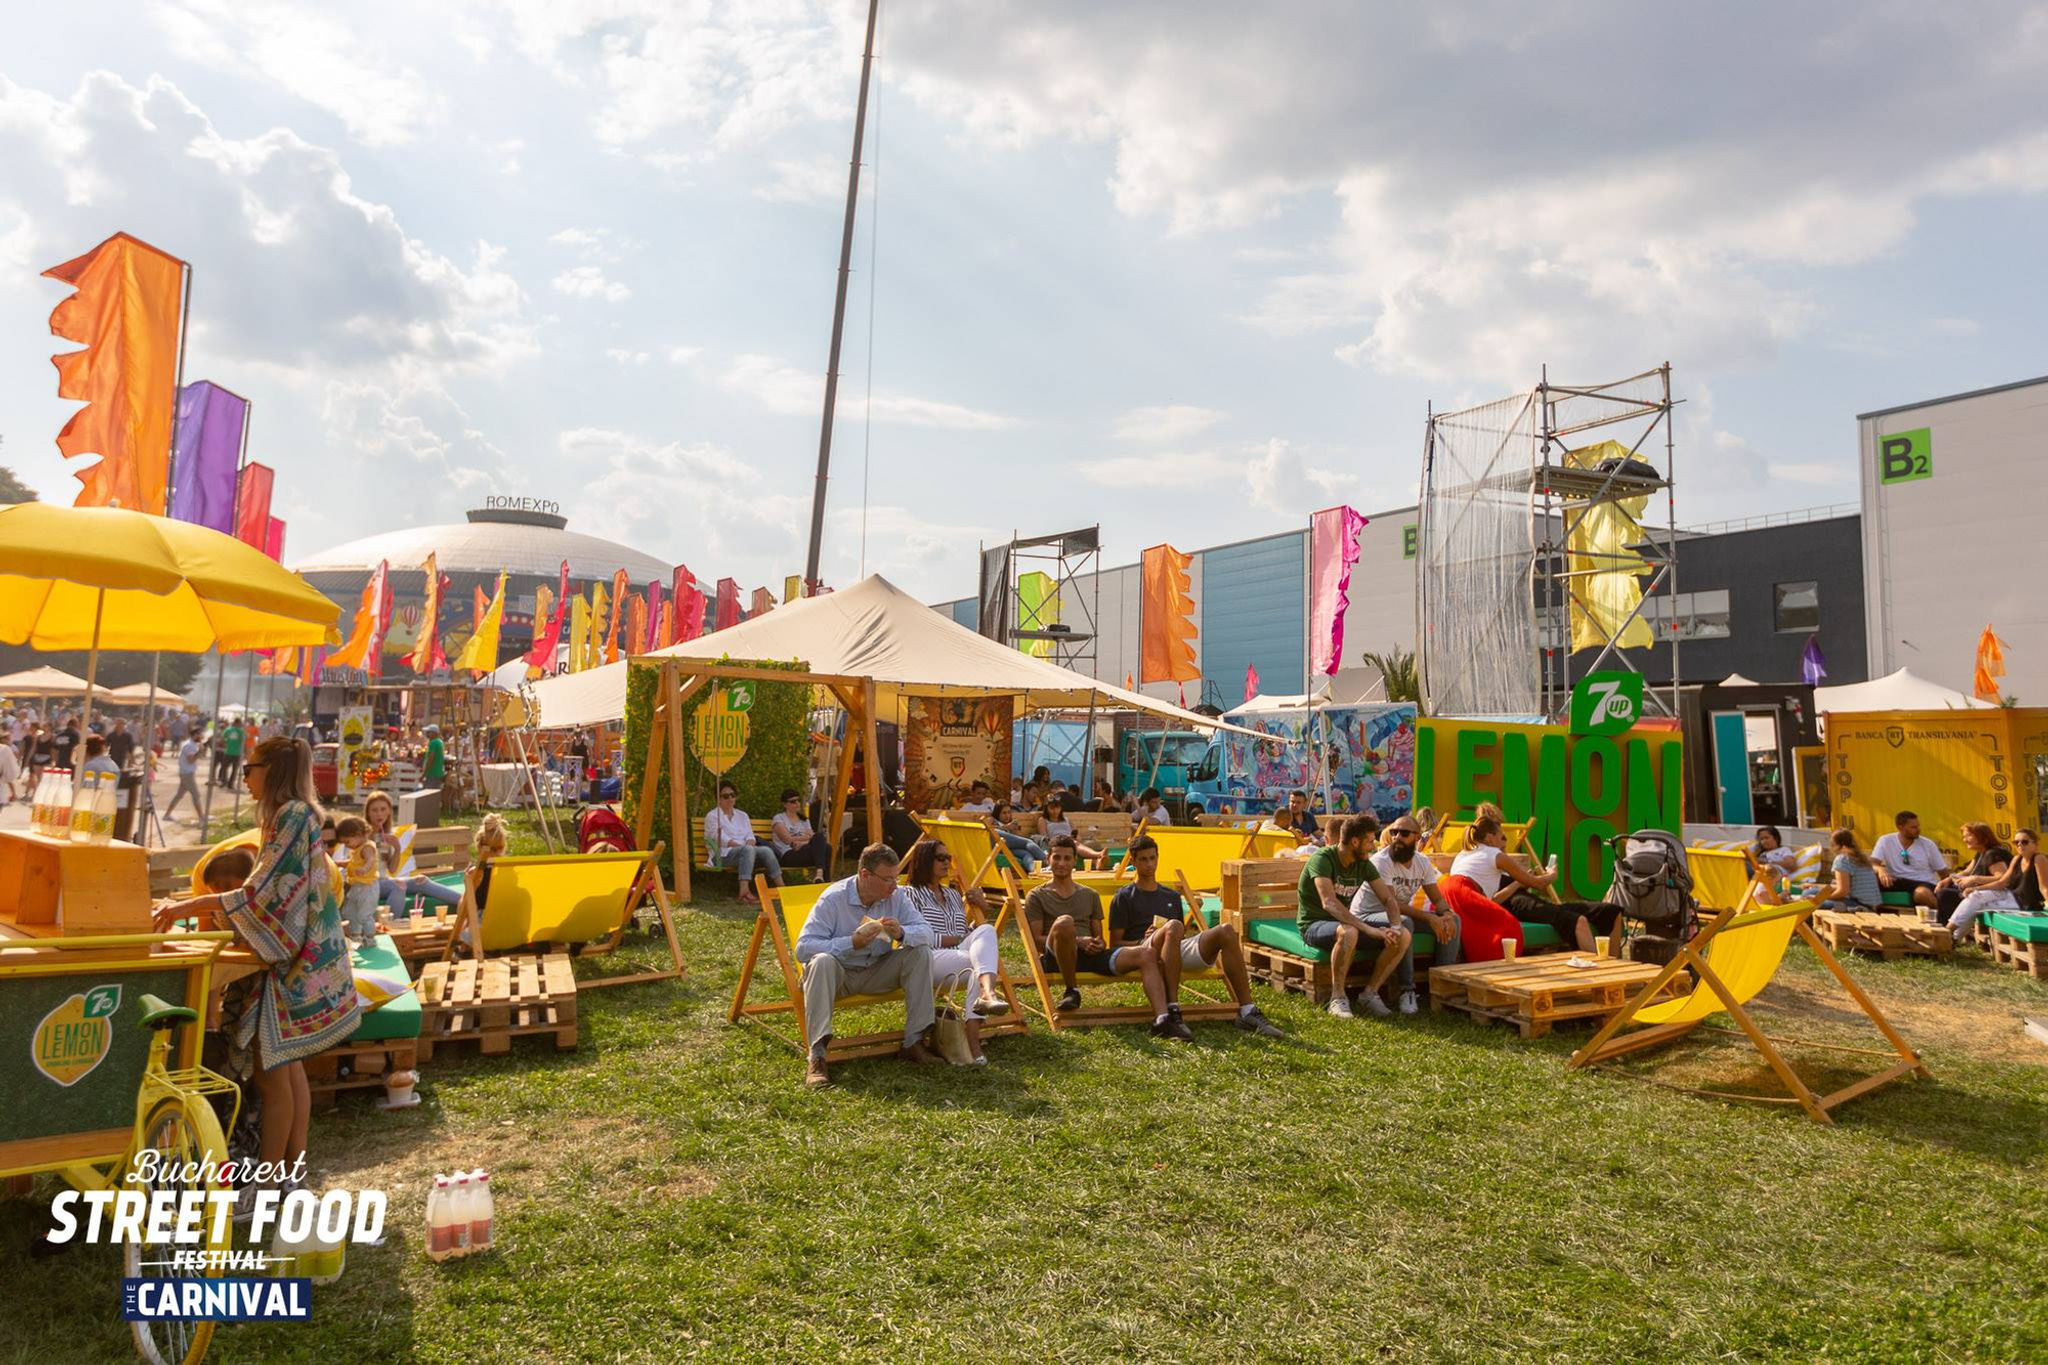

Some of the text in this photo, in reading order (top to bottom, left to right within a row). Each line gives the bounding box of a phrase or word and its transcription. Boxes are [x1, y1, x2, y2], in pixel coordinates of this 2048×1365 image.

[486, 495, 560, 514] ROMEXPO
[943, 727, 977, 737] CARNIVAL
[1855, 731, 1884, 740] BANCA
[1908, 731, 1975, 740] TRANSILVANIA
